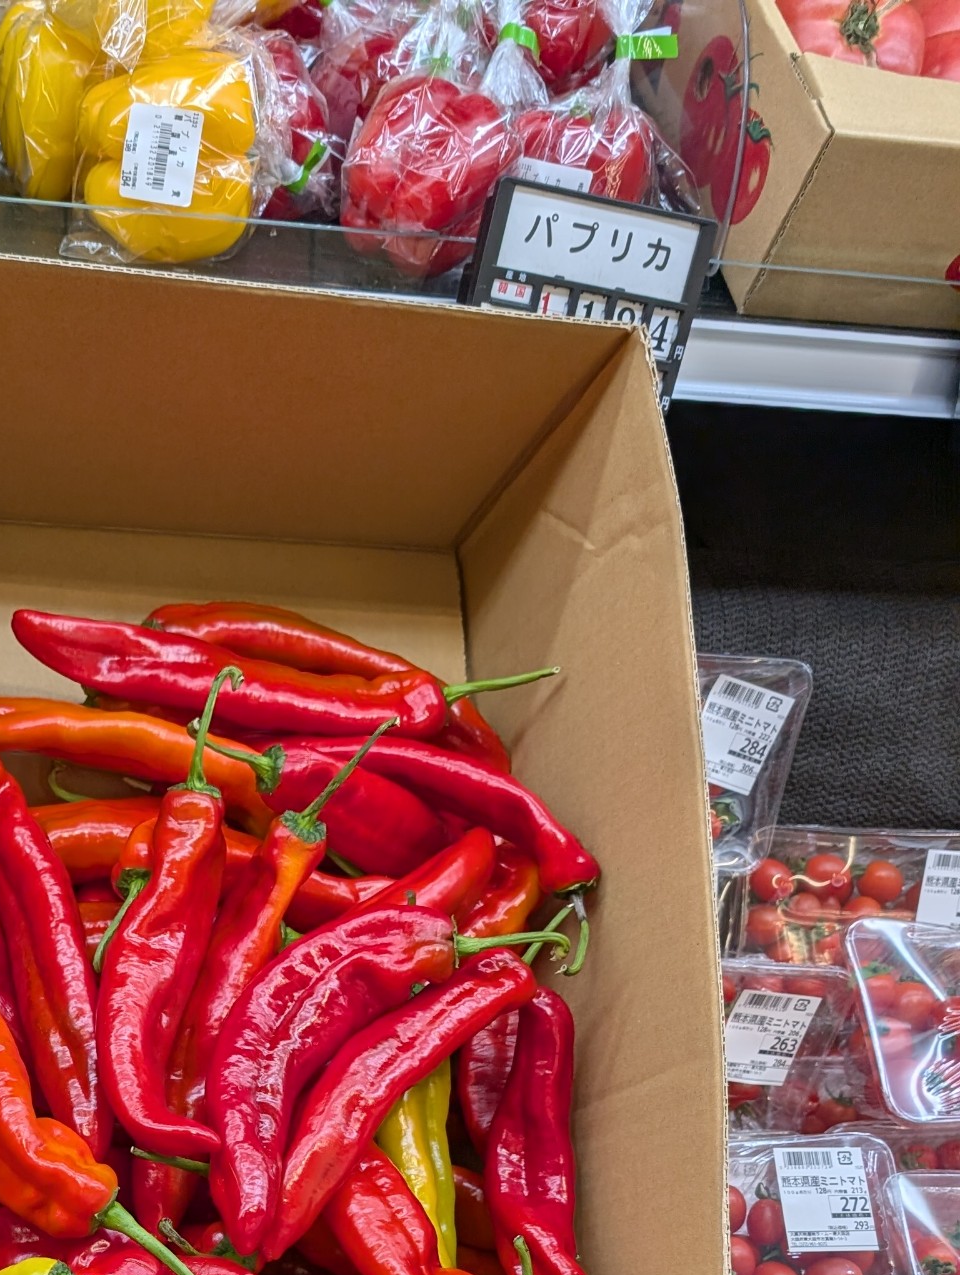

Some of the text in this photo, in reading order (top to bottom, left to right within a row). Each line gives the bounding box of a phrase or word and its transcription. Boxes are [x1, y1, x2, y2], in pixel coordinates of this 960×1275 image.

[121, 169, 132, 187] 184
[524, 213, 671, 272] パプリカ
[739, 738, 768, 759] 284
[770, 1036, 798, 1053] 263
[782, 1175, 866, 1187] 熊本県産ミニトマト
[839, 1197, 870, 1212] 272
